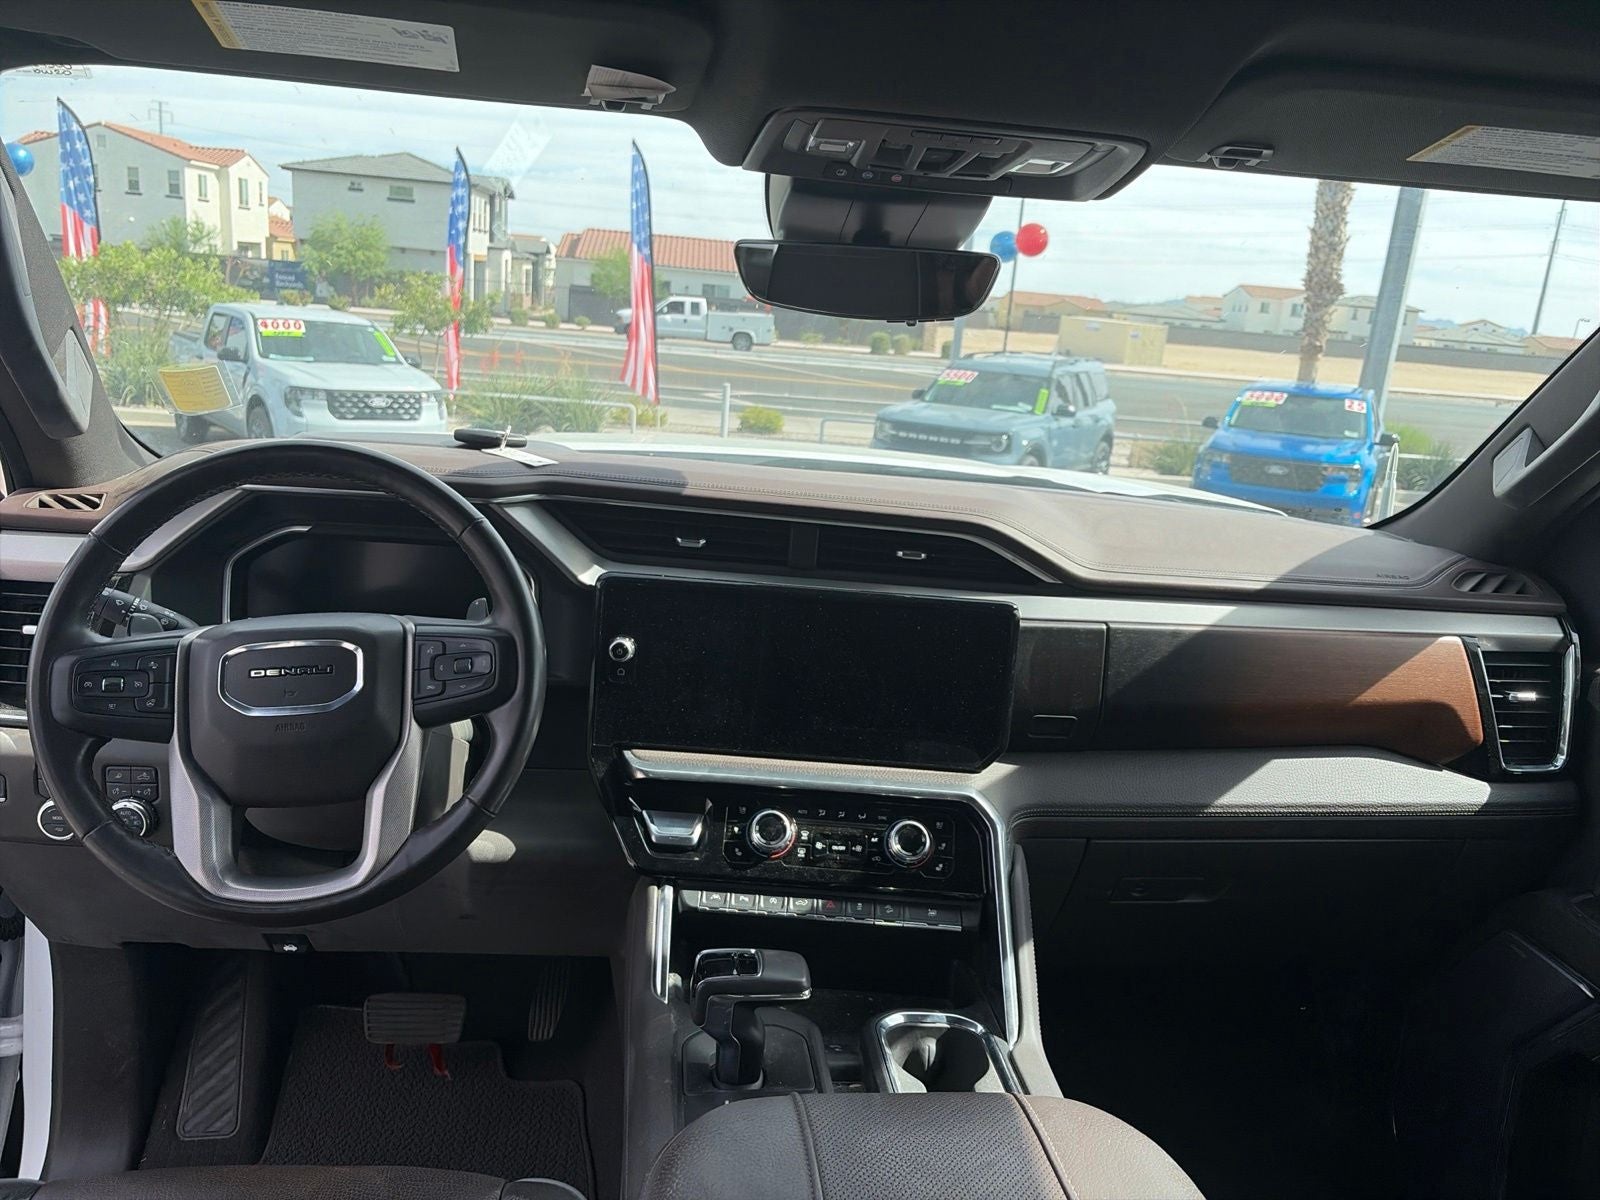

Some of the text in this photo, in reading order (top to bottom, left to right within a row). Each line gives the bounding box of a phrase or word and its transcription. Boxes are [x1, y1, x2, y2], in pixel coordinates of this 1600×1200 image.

[260, 319, 302, 330] 4000
[898, 431, 961, 445] BRONCO
[249, 665, 335, 678] DENALI
